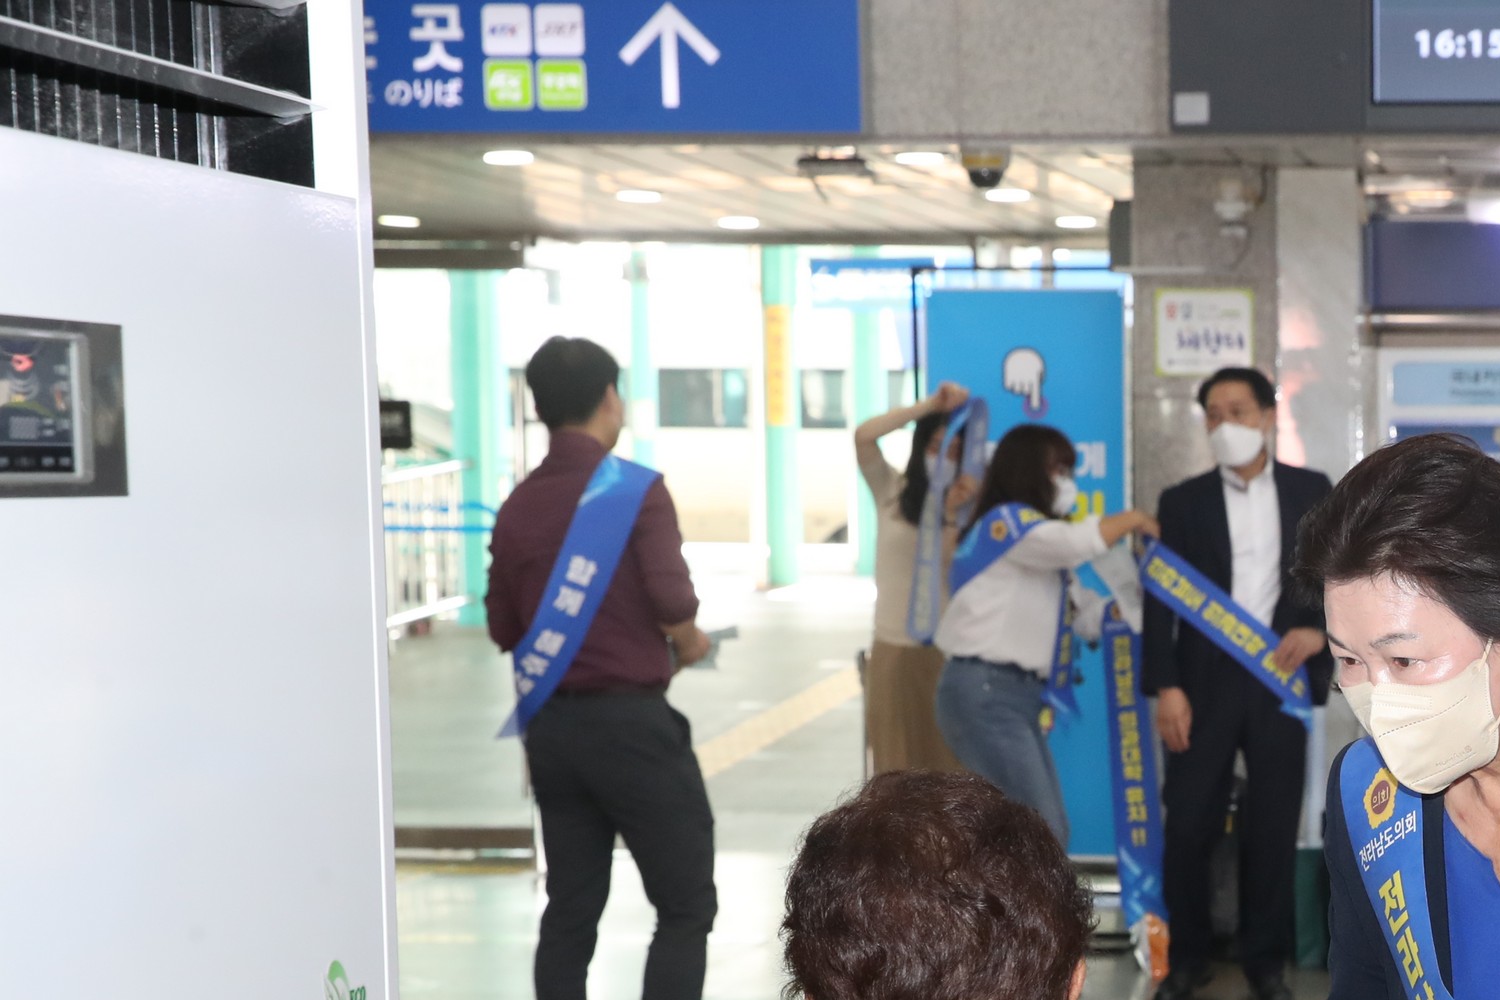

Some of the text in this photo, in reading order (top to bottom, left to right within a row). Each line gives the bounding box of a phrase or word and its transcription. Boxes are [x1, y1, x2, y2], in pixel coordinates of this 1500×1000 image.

[409, 3, 464, 73] 곳
[384, 77, 464, 109] のりば
[1371, 785, 1391, 809] 의회
[1358, 810, 1417, 873] 전라남도의회
